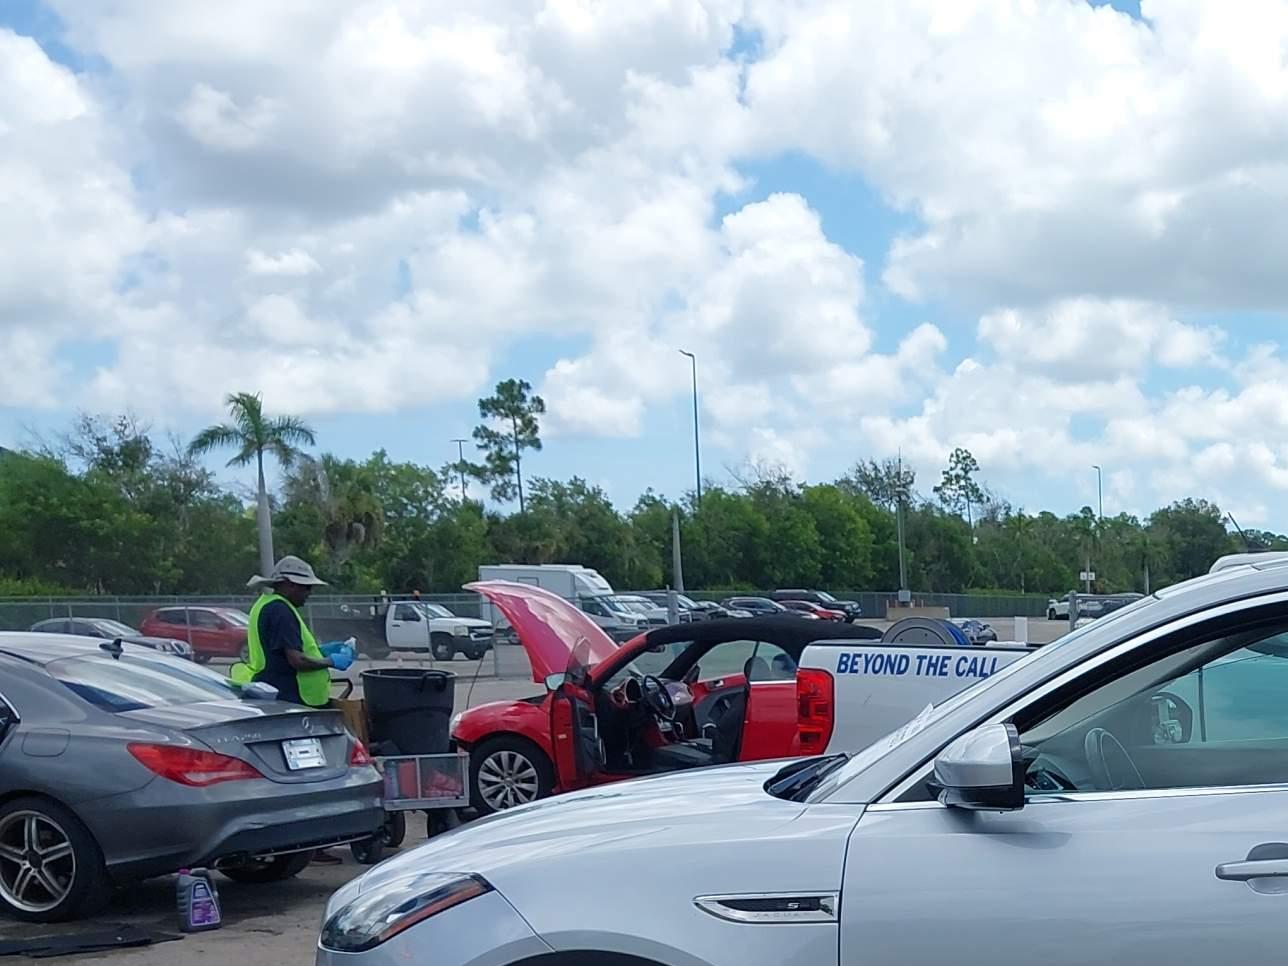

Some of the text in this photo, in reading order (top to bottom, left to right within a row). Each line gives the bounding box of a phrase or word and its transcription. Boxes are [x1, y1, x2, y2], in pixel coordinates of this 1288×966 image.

[836, 653, 998, 677] BEYOND THE CALL
